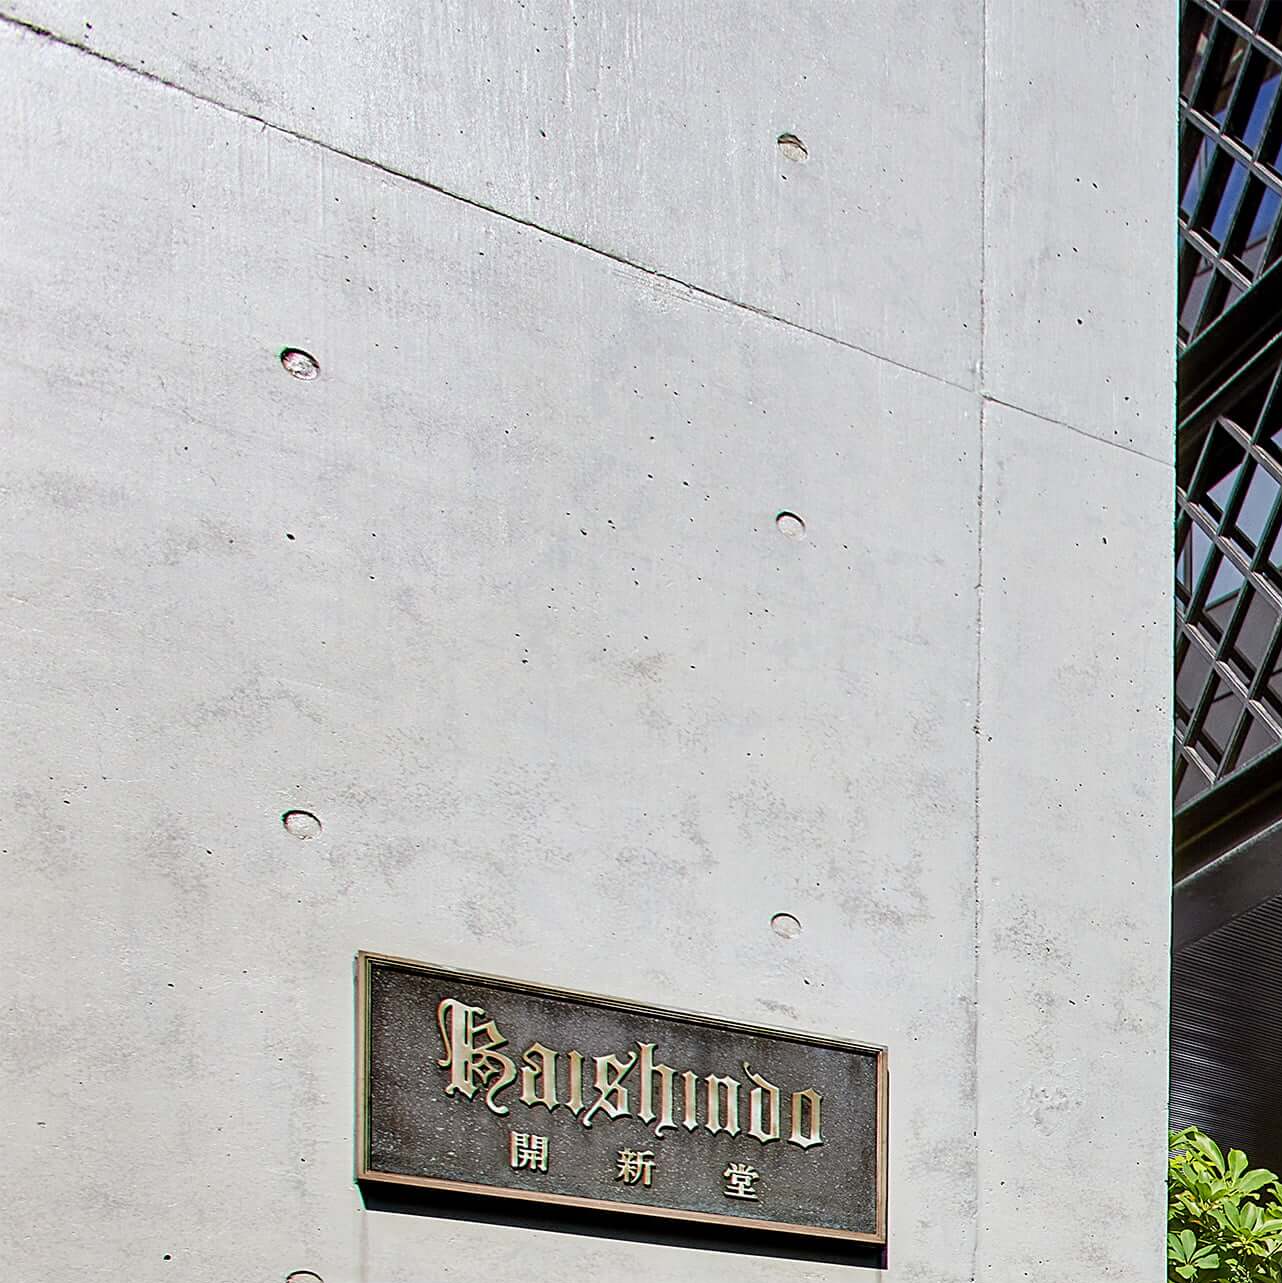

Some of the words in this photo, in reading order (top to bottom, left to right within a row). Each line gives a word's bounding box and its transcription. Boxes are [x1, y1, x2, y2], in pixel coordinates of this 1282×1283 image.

[437, 997, 825, 1150] Kaishindo
[510, 1130, 761, 1201] 開新堂
